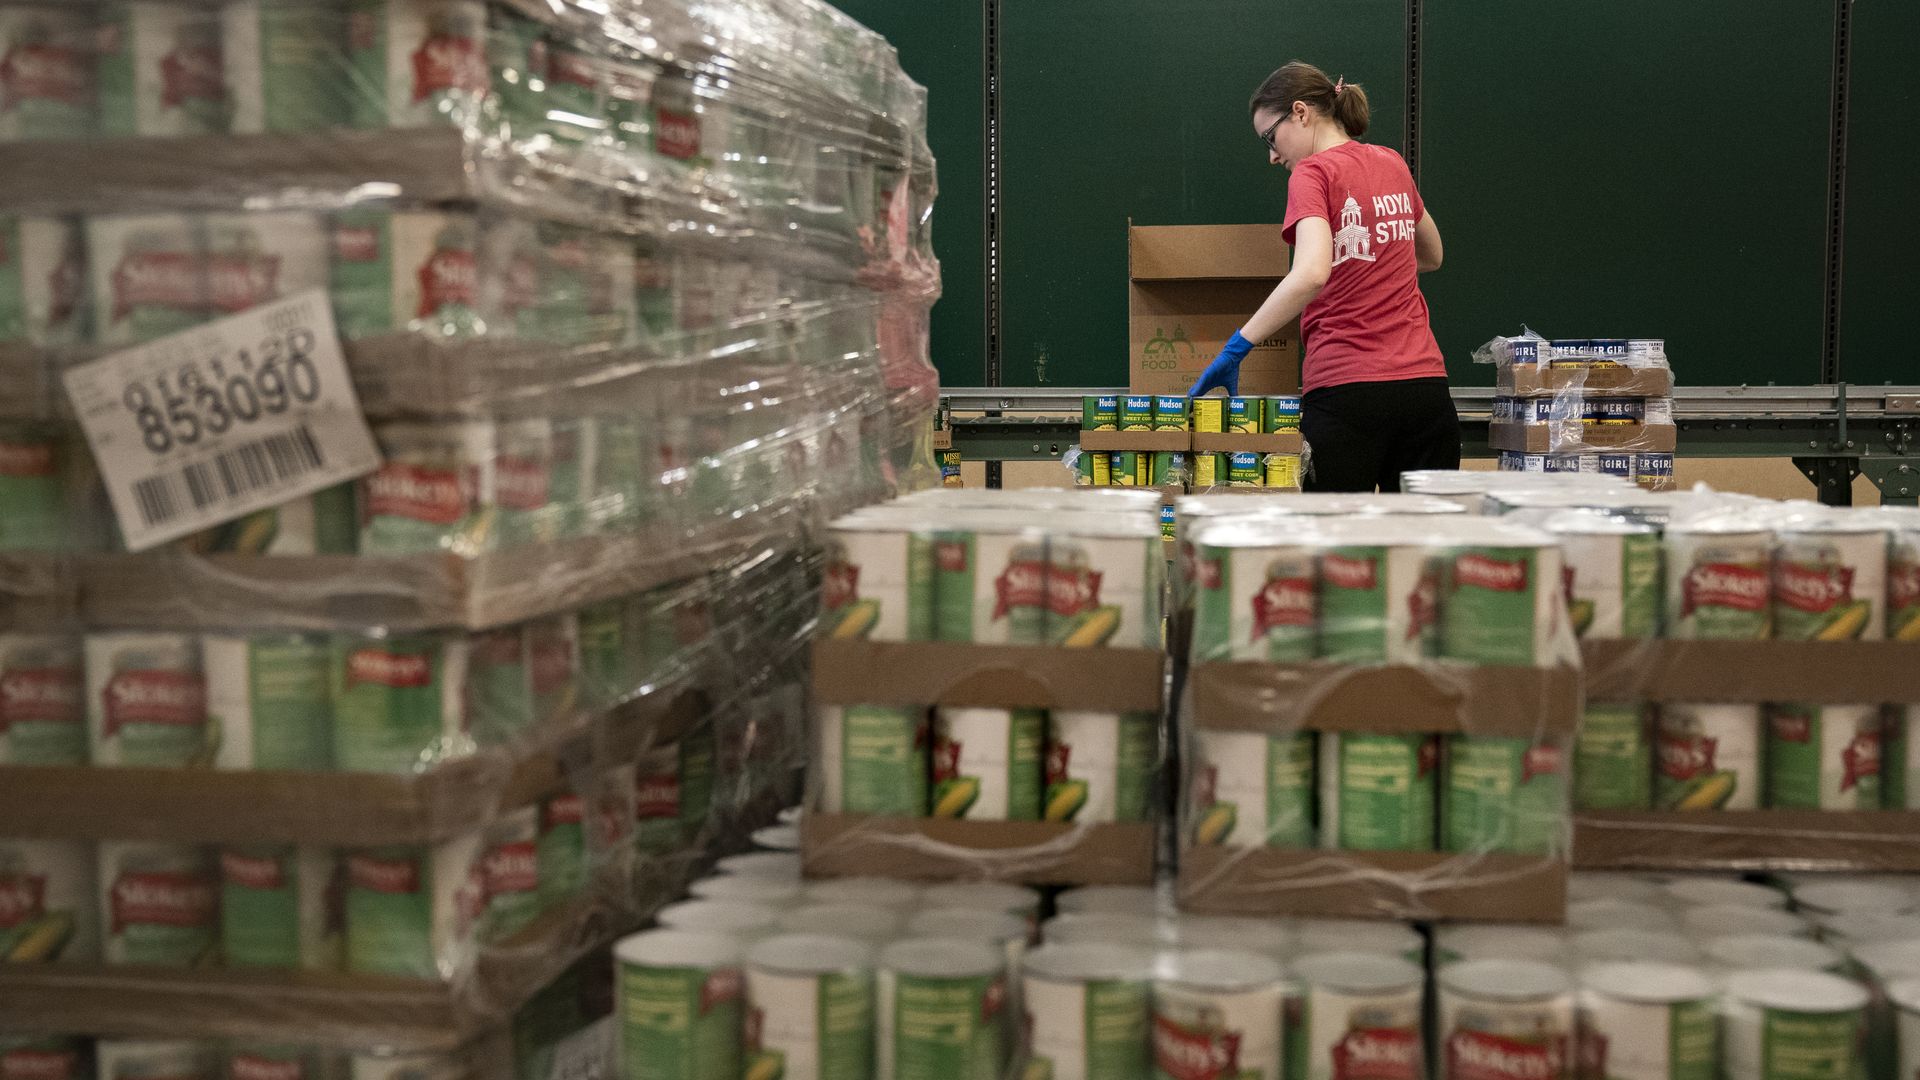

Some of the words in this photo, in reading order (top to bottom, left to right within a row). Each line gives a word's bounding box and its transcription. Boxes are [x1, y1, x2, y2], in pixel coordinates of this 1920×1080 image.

[1372, 192, 1412, 217] HOYA
[1515, 347, 1535, 356] GIRL
[1141, 360, 1177, 370] FOOD
[136, 353, 321, 454] 853090
[1127, 398, 1151, 408] Hudson
[1159, 399, 1182, 409] Hudson
[1605, 459, 1628, 468] GIRL
[1652, 459, 1672, 468] GIRL
